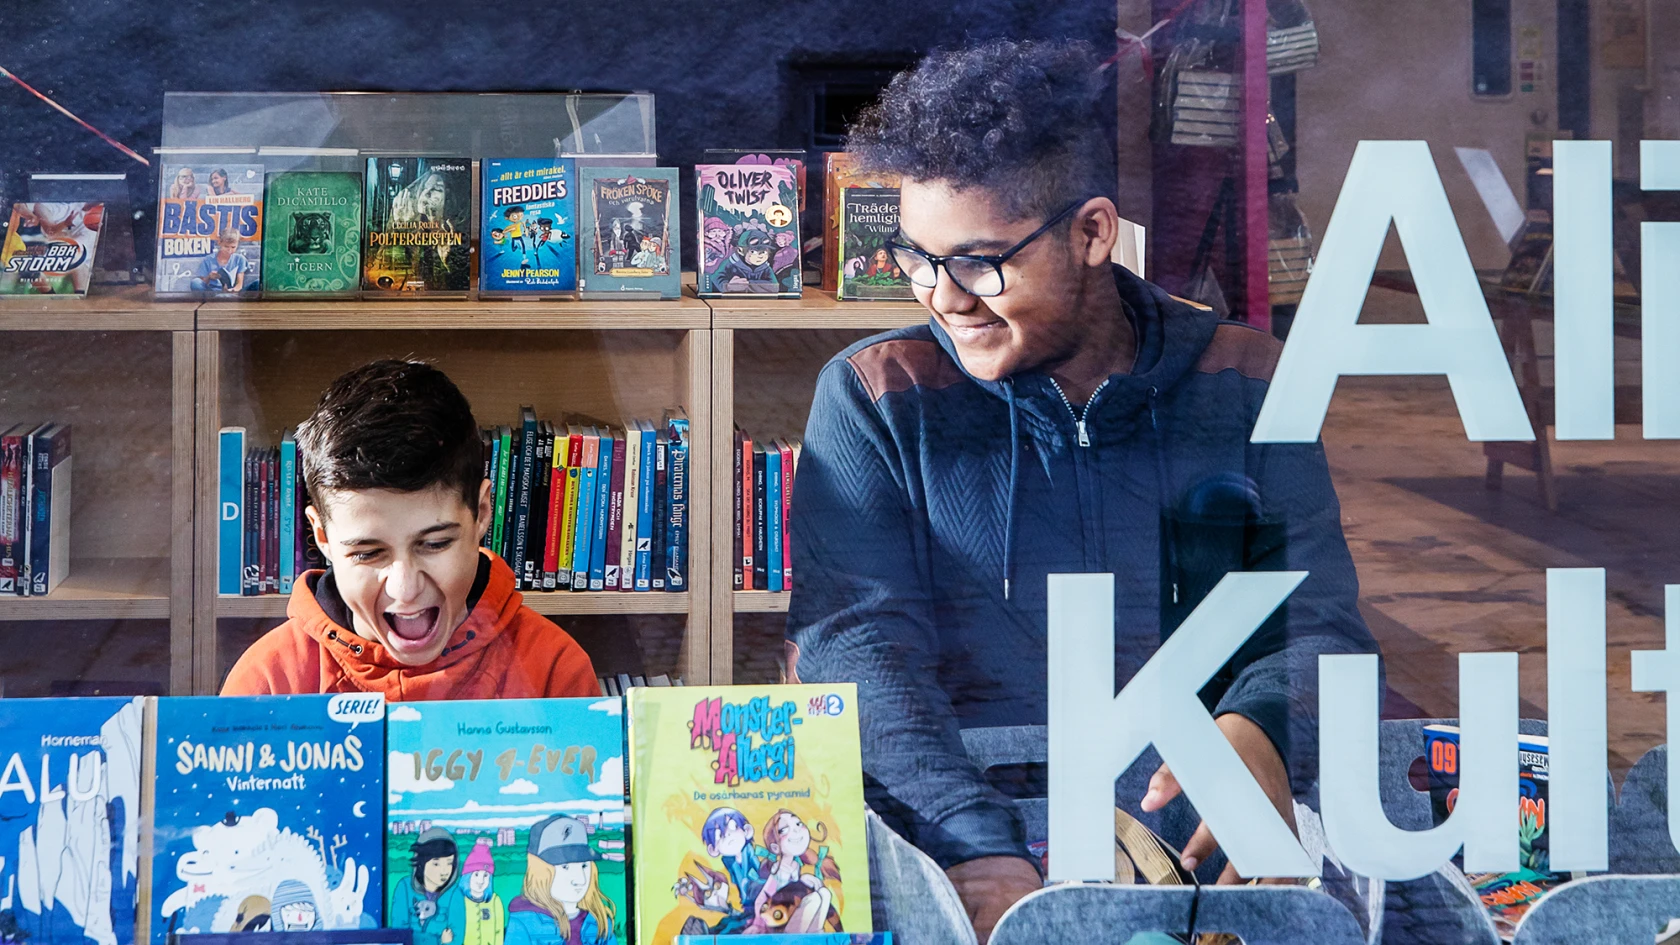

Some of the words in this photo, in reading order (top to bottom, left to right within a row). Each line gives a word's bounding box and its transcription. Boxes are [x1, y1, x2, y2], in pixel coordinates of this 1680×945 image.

[500, 172, 512, 181] allt
[524, 170, 534, 178] ett
[716, 169, 774, 190] OLIVER
[296, 187, 328, 196] KATE
[494, 180, 567, 205] FREDDIES
[601, 185, 635, 200] FRÖKEN
[636, 184, 663, 203] SPÖKE
[724, 188, 770, 205] TWIST
[847, 203, 901, 214] Träde
[164, 237, 211, 256] BOKEN
[370, 231, 462, 246] POLTERGEISTEN
[6, 257, 72, 272] STORM
[501, 269, 525, 278] JENNY
[526, 269, 560, 278] PEARSON
[526, 430, 534, 445] ELISE
[525, 445, 533, 456] OCH
[522, 467, 530, 490] MAGISKA
[672, 449, 686, 500] Piraternas
[520, 490, 528, 508] HUSET
[222, 502, 240, 520] D
[335, 699, 380, 715] SERIE!
[828, 695, 841, 715] 2
[458, 722, 492, 736] Hanna
[496, 721, 552, 735] Gustavsson
[176, 741, 254, 775] SANNI
[258, 744, 276, 769] &
[280, 734, 364, 773] JONAS
[413, 748, 484, 782] IGGY
[495, 744, 597, 784] 4-EVER
[226, 773, 306, 792] Vinternatt
[694, 791, 706, 800] De
[710, 788, 764, 800] osårbaras
[766, 787, 810, 801] pyramid
